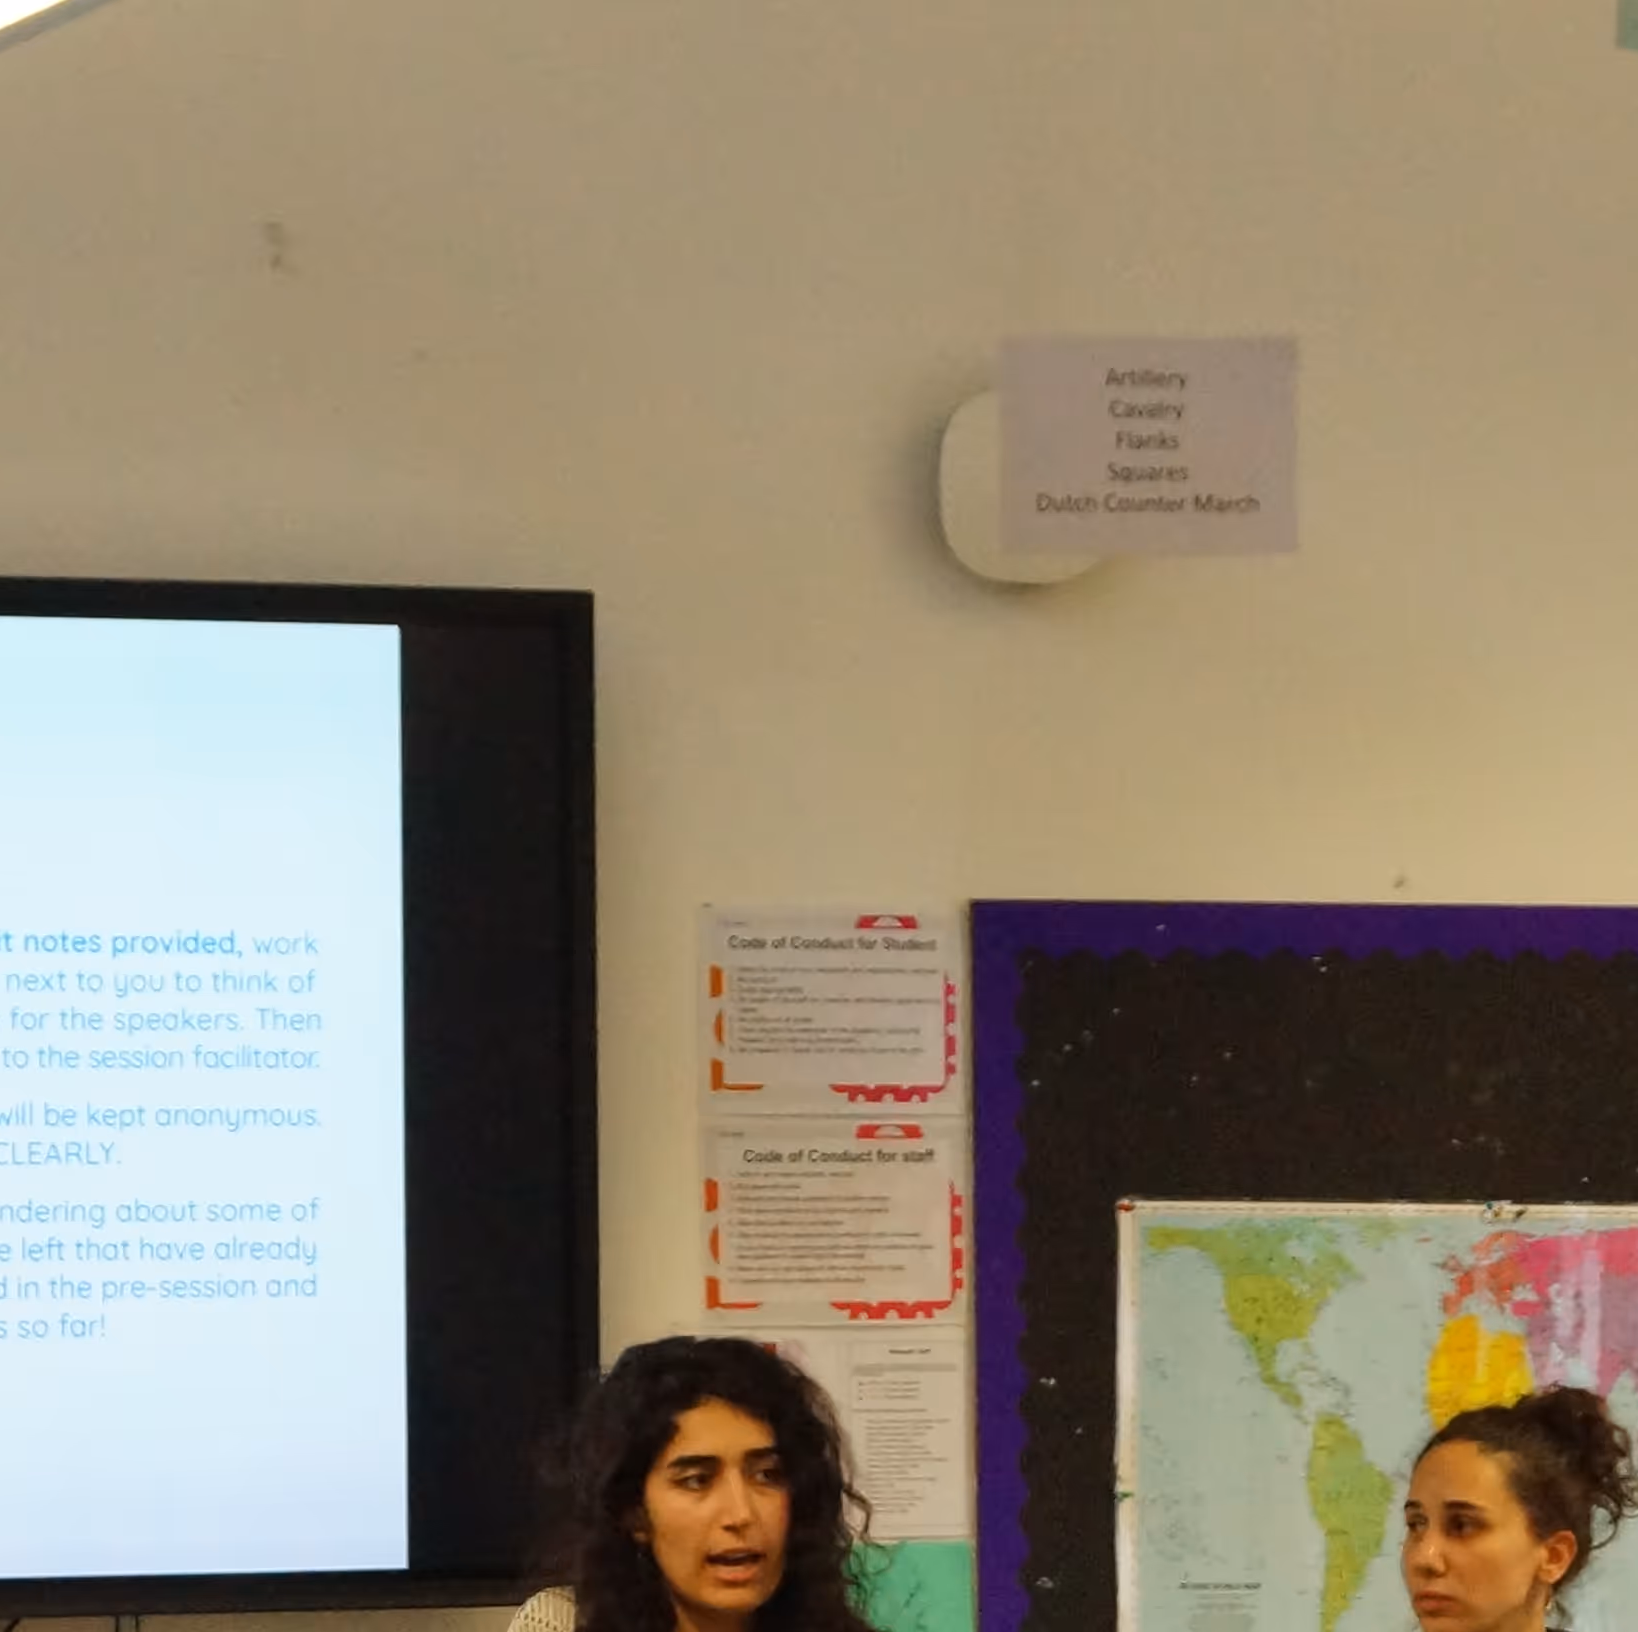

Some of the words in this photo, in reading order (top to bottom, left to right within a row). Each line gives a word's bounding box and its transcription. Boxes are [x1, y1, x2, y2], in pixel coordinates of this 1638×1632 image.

[1105, 367, 1188, 391] Artillery
[1108, 399, 1184, 420] Cavalry
[1115, 430, 1179, 450] Flanks
[1107, 463, 1189, 483] Squares
[1035, 492, 1098, 513] Dutch
[1102, 492, 1186, 513] Counter
[1193, 492, 1261, 513] March
[22, 930, 104, 955] notes
[110, 929, 244, 960] provided,
[252, 931, 319, 955] work
[728, 935, 767, 951] Code
[771, 935, 786, 950] of
[790, 935, 854, 951] Conduct
[858, 935, 878, 951] for
[3, 970, 67, 992] next
[75, 970, 106, 994] to
[113, 974, 166, 1000] you
[172, 970, 203, 994] to
[211, 969, 278, 994] think
[288, 968, 317, 995] of
[9, 1006, 51, 1031] for
[58, 1006, 105, 1032] the
[113, 1007, 244, 1037] speakers.
[255, 1007, 323, 1033] Then
[1, 1047, 30, 1069] to
[36, 1044, 83, 1070] the
[87, 1046, 187, 1071] session
[192, 1044, 320, 1070] facilitator.
[43, 1102, 79, 1128] be
[86, 1102, 147, 1132] kept
[155, 1108, 321, 1132] anonymous.
[742, 1148, 784, 1164] Code
[787, 1148, 804, 1164] of
[807, 1148, 872, 1164] Conduct
[876, 1148, 897, 1164] for
[901, 1148, 934, 1164] staff
[115, 1198, 199, 1223] about
[206, 1203, 284, 1223] some
[290, 1197, 320, 1222] of
[22, 1236, 67, 1263] left
[74, 1237, 131, 1262] that
[139, 1236, 206, 1262] have
[213, 1235, 319, 1267] already
[17, 1277, 40, 1300] in
[47, 1274, 92, 1300] the
[102, 1274, 258, 1304] pre-session
[266, 1273, 318, 1298] and
[17, 1319, 50, 1339] so
[57, 1312, 105, 1339] far!
